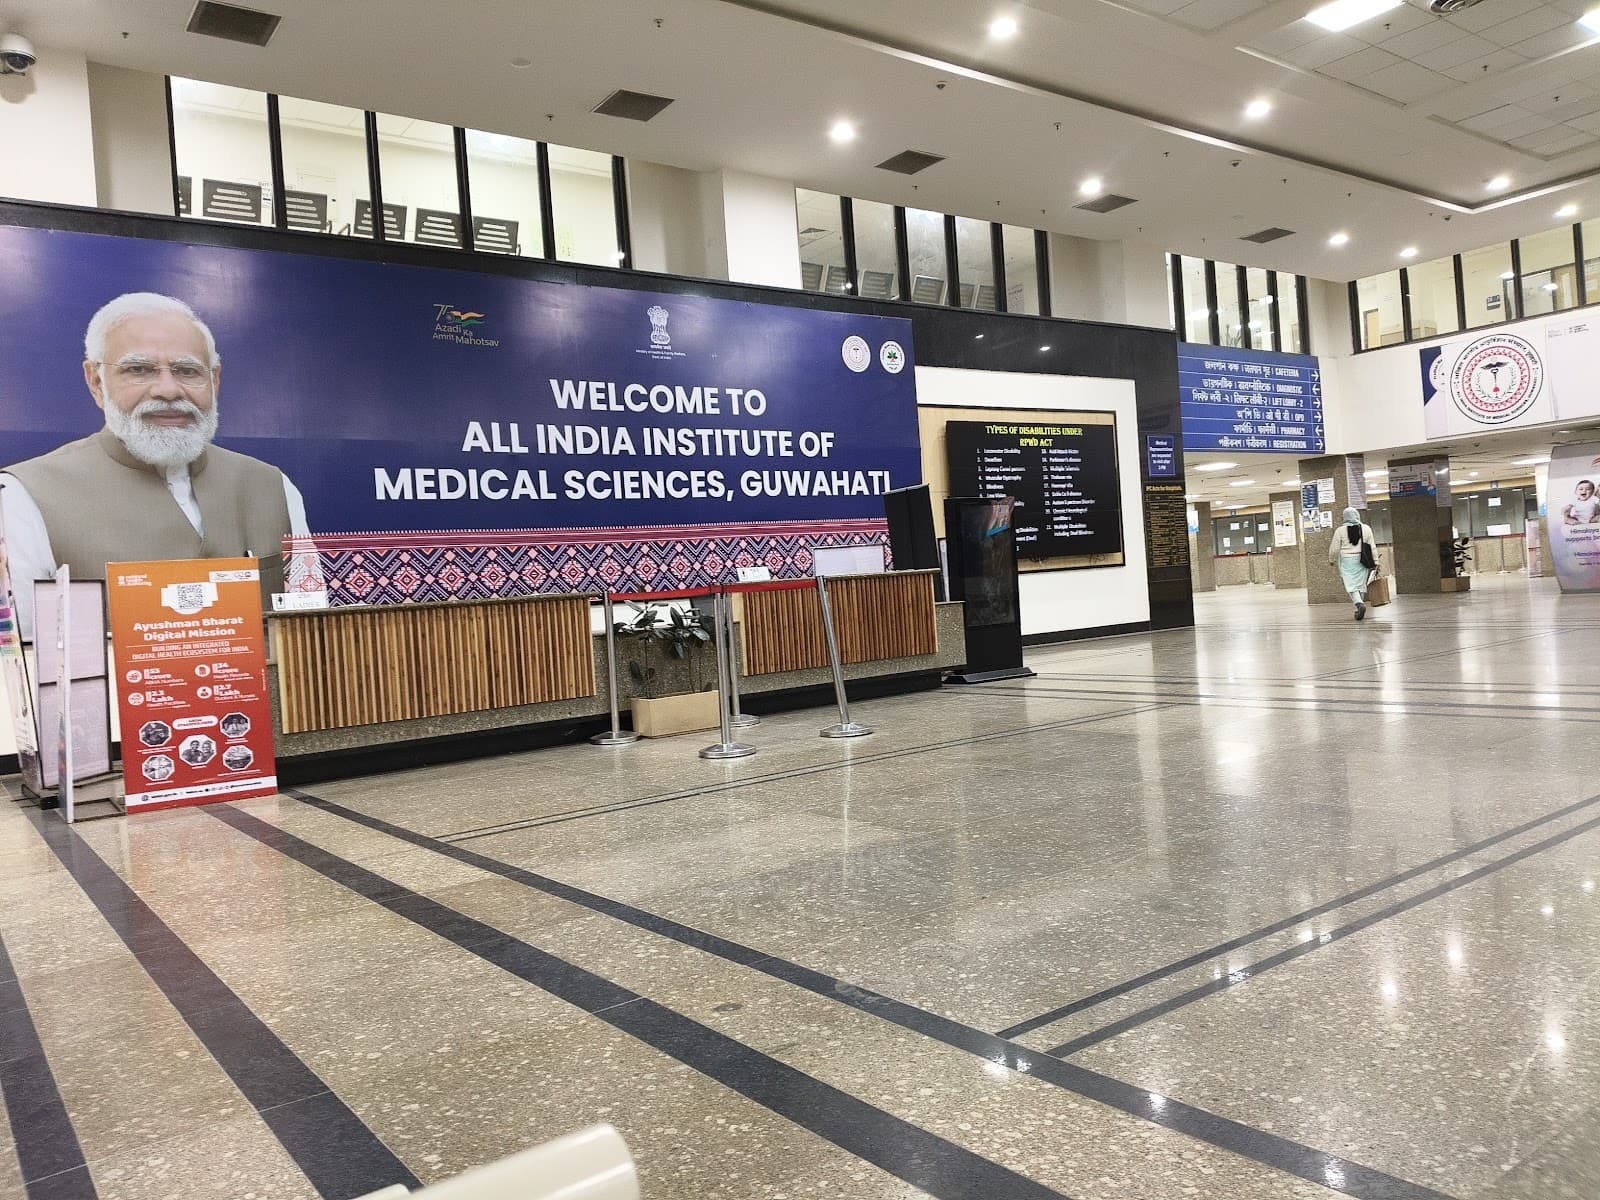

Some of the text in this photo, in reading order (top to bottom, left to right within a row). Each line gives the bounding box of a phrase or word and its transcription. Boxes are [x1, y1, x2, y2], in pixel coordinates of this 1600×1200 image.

[435, 323, 462, 332] Azadi
[432, 332, 500, 347] Amrit Mahotsav
[1275, 367, 1300, 378] CAFETERIA
[1276, 384, 1303, 394] DIAGNOSTIC
[549, 378, 767, 416] WELCOME TO
[985, 424, 1008, 435] TYPES
[1009, 426, 1018, 435] OF
[1019, 426, 1061, 436] DISABILITIES
[1280, 426, 1305, 436] PHARMACY
[462, 421, 835, 458] ALL INDIA INSTITUTE OF
[1040, 438, 1054, 447] ACT
[1272, 440, 1307, 449] REGISTRATION
[374, 468, 891, 502] MEDICAL SCIENCES, GUWAHATI
[133, 616, 244, 632] Ayushman Bharat
[144, 628, 236, 642] Digital Mission
[152, 644, 181, 652] BUILDING
[192, 641, 230, 650] INTEGRATED
[183, 648, 218, 657] ECOSYSTEM
